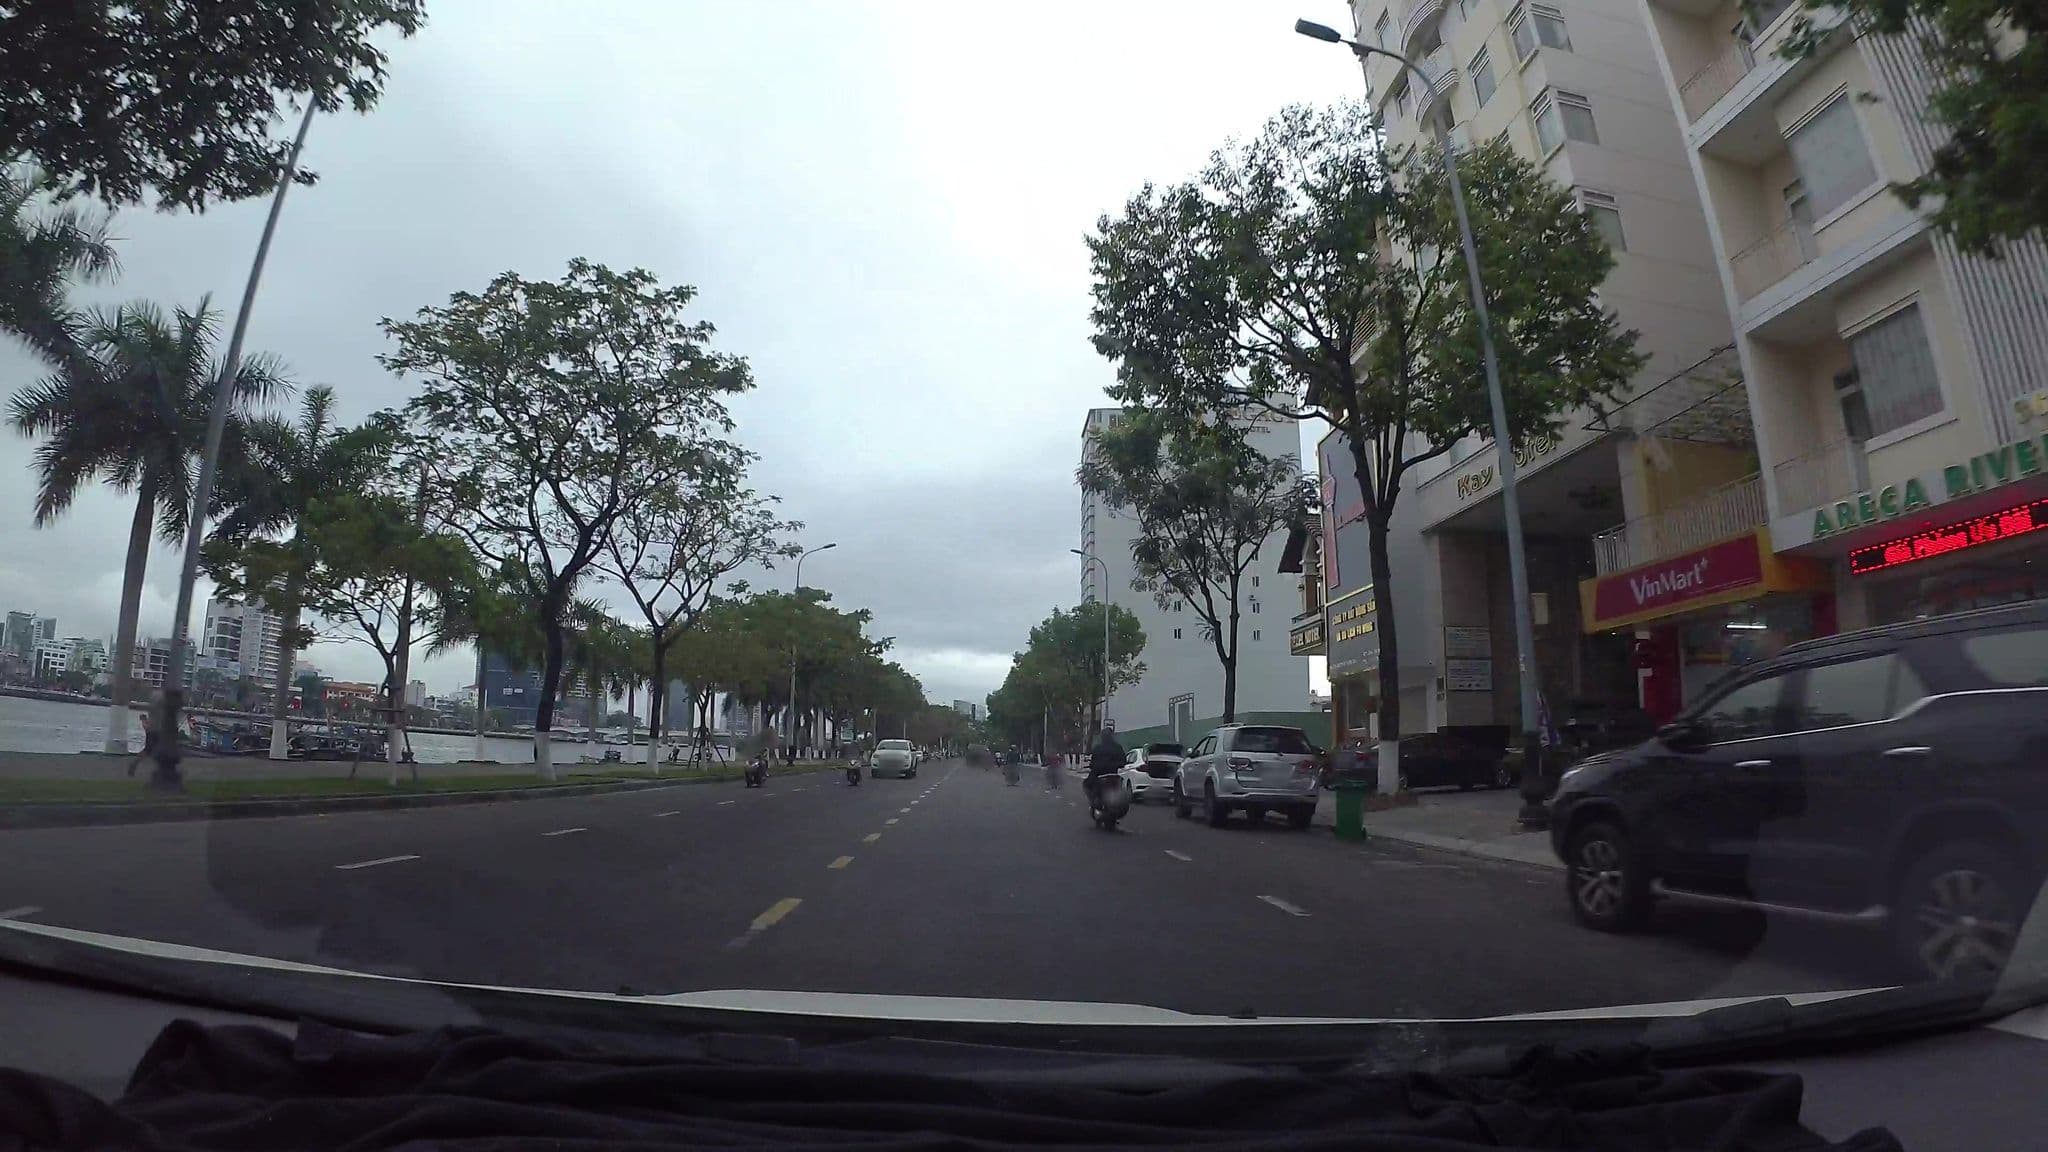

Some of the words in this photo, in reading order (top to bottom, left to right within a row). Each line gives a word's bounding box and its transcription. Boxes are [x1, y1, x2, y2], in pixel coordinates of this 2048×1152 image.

[1458, 464, 1494, 500] Kay
[1498, 431, 1557, 475] otel
[1943, 433, 2048, 498] RIVE
